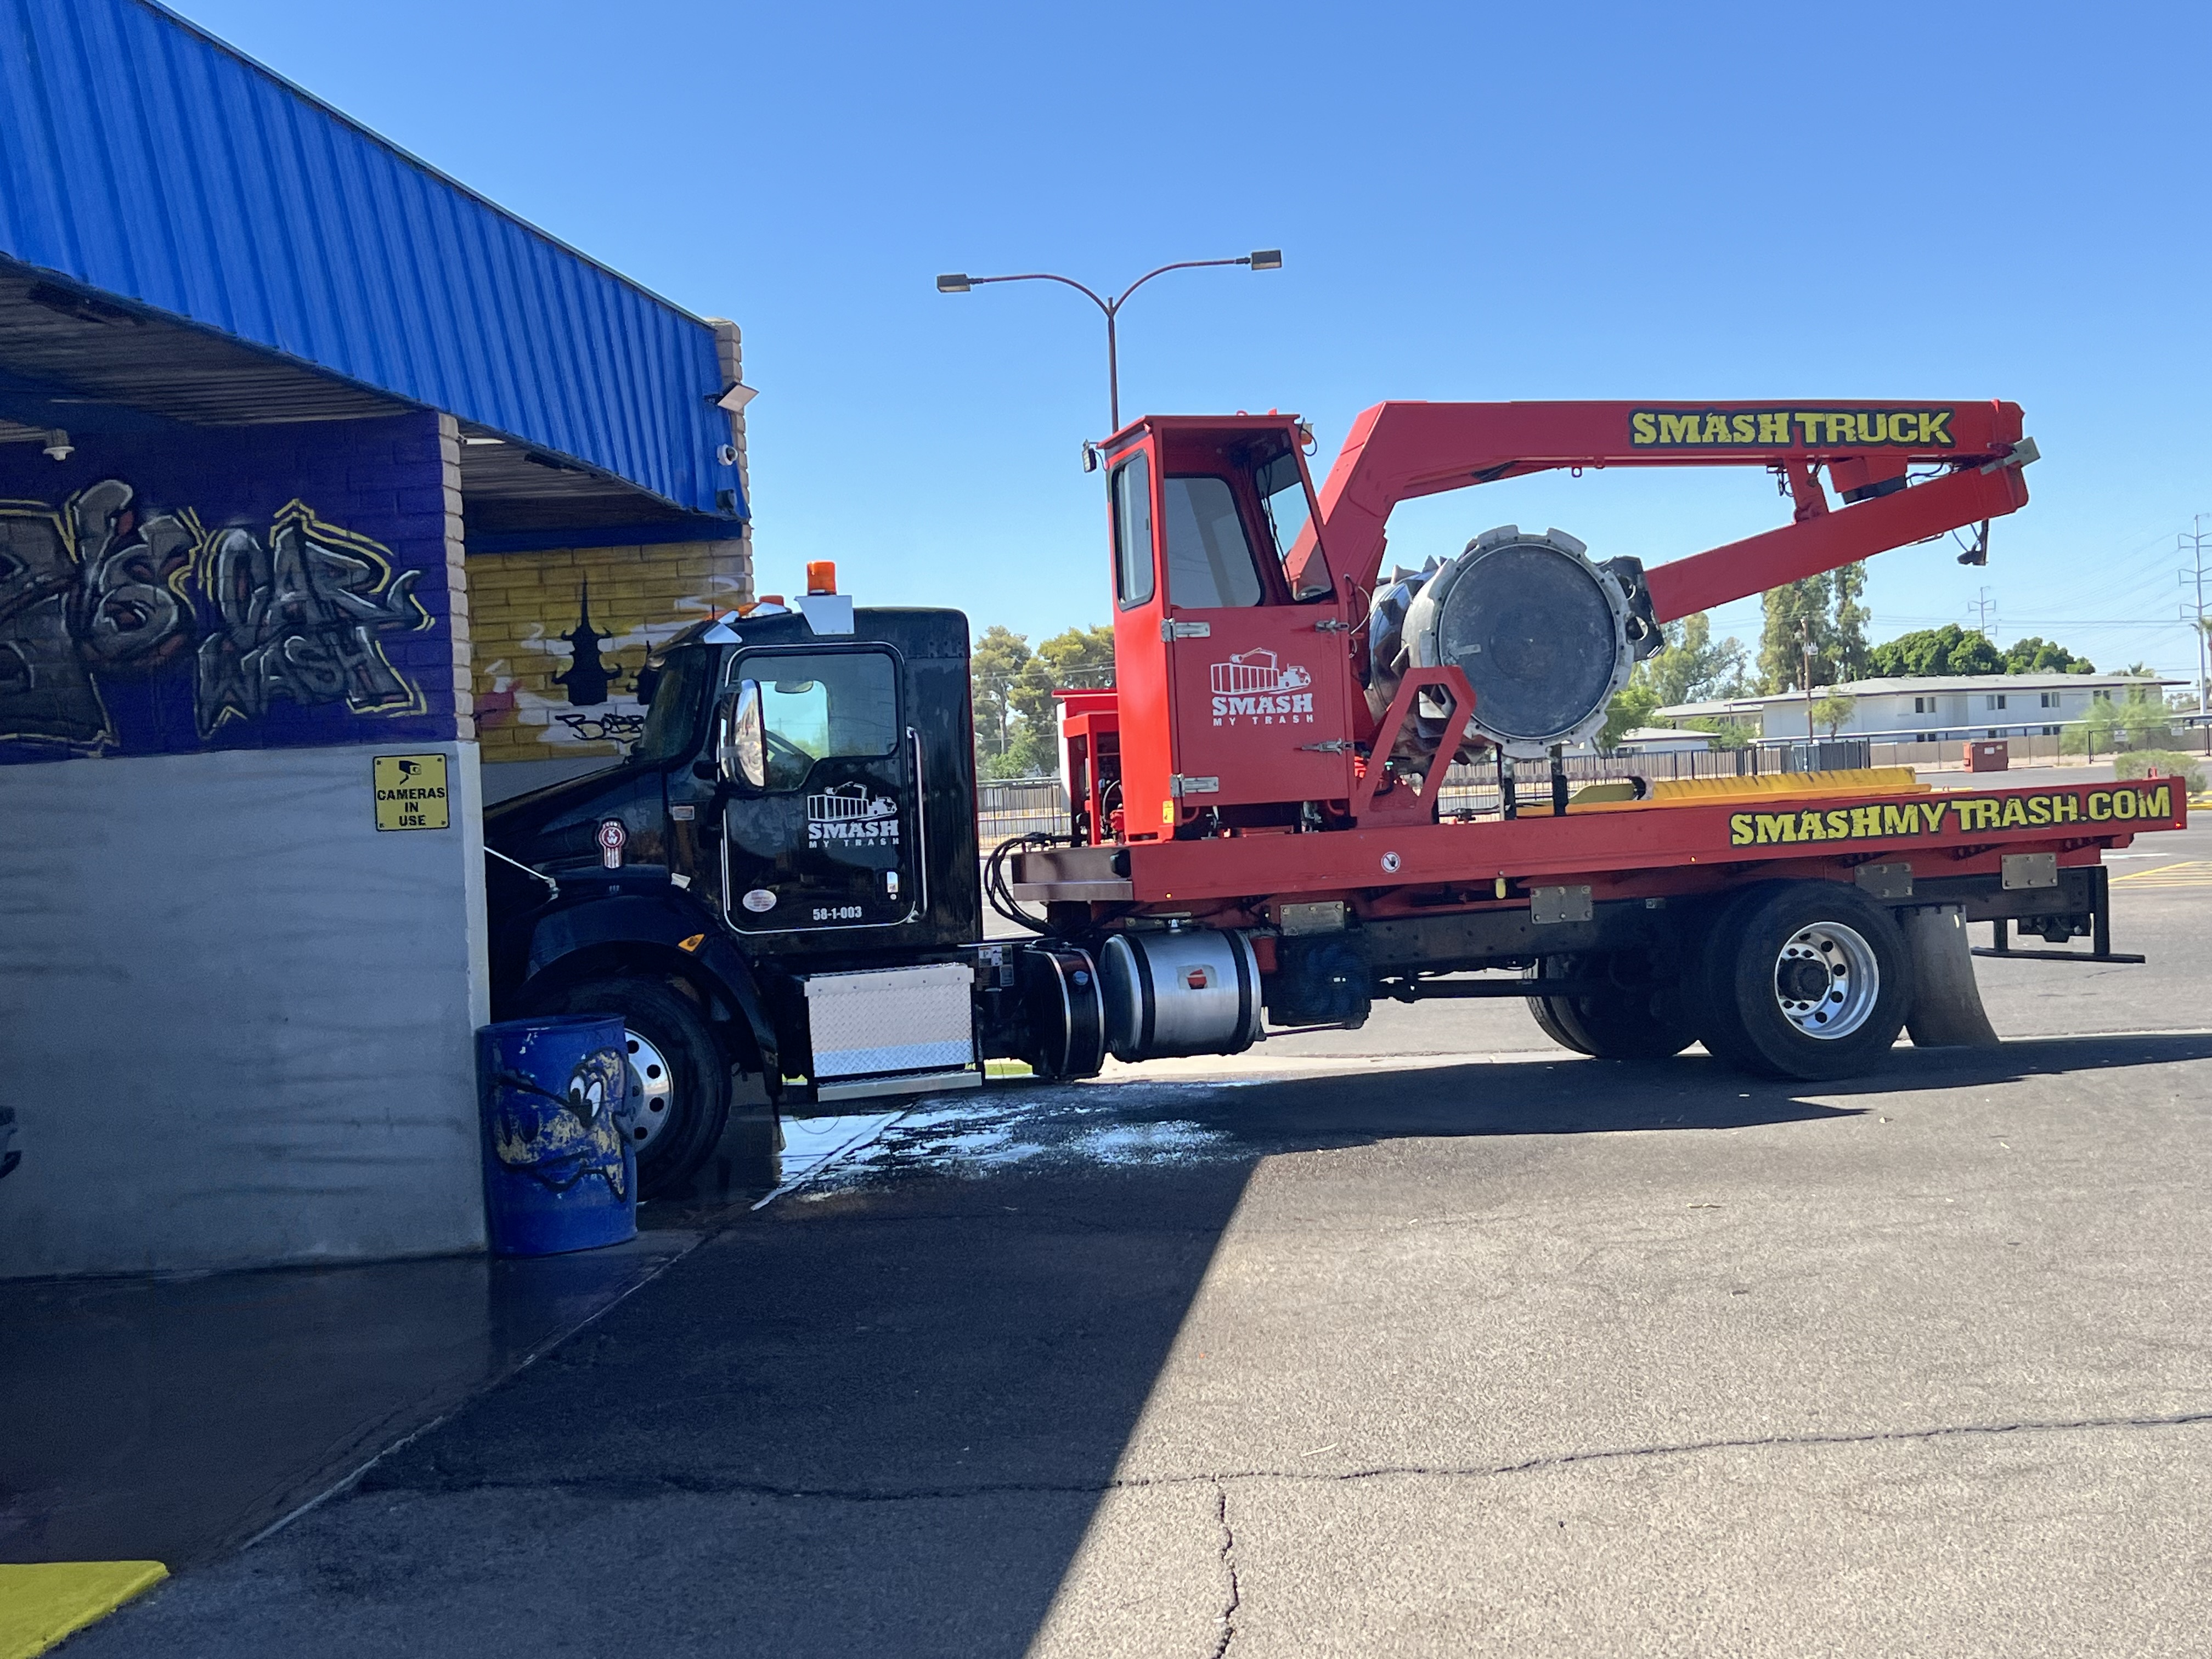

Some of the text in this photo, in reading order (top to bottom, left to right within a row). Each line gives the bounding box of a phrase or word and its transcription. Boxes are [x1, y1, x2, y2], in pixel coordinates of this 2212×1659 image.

[1632, 411, 1952, 444] SMASH TRUCK
[1212, 693, 1313, 715] SMASH
[1213, 714, 1313, 726] MY TRASH
[377, 787, 445, 800] CAMERAS
[405, 802, 419, 812] IN
[399, 815, 426, 826] USE
[808, 820, 899, 839] SMASH
[844, 838, 899, 847] TRASH
[812, 906, 862, 920] 58-1-003
